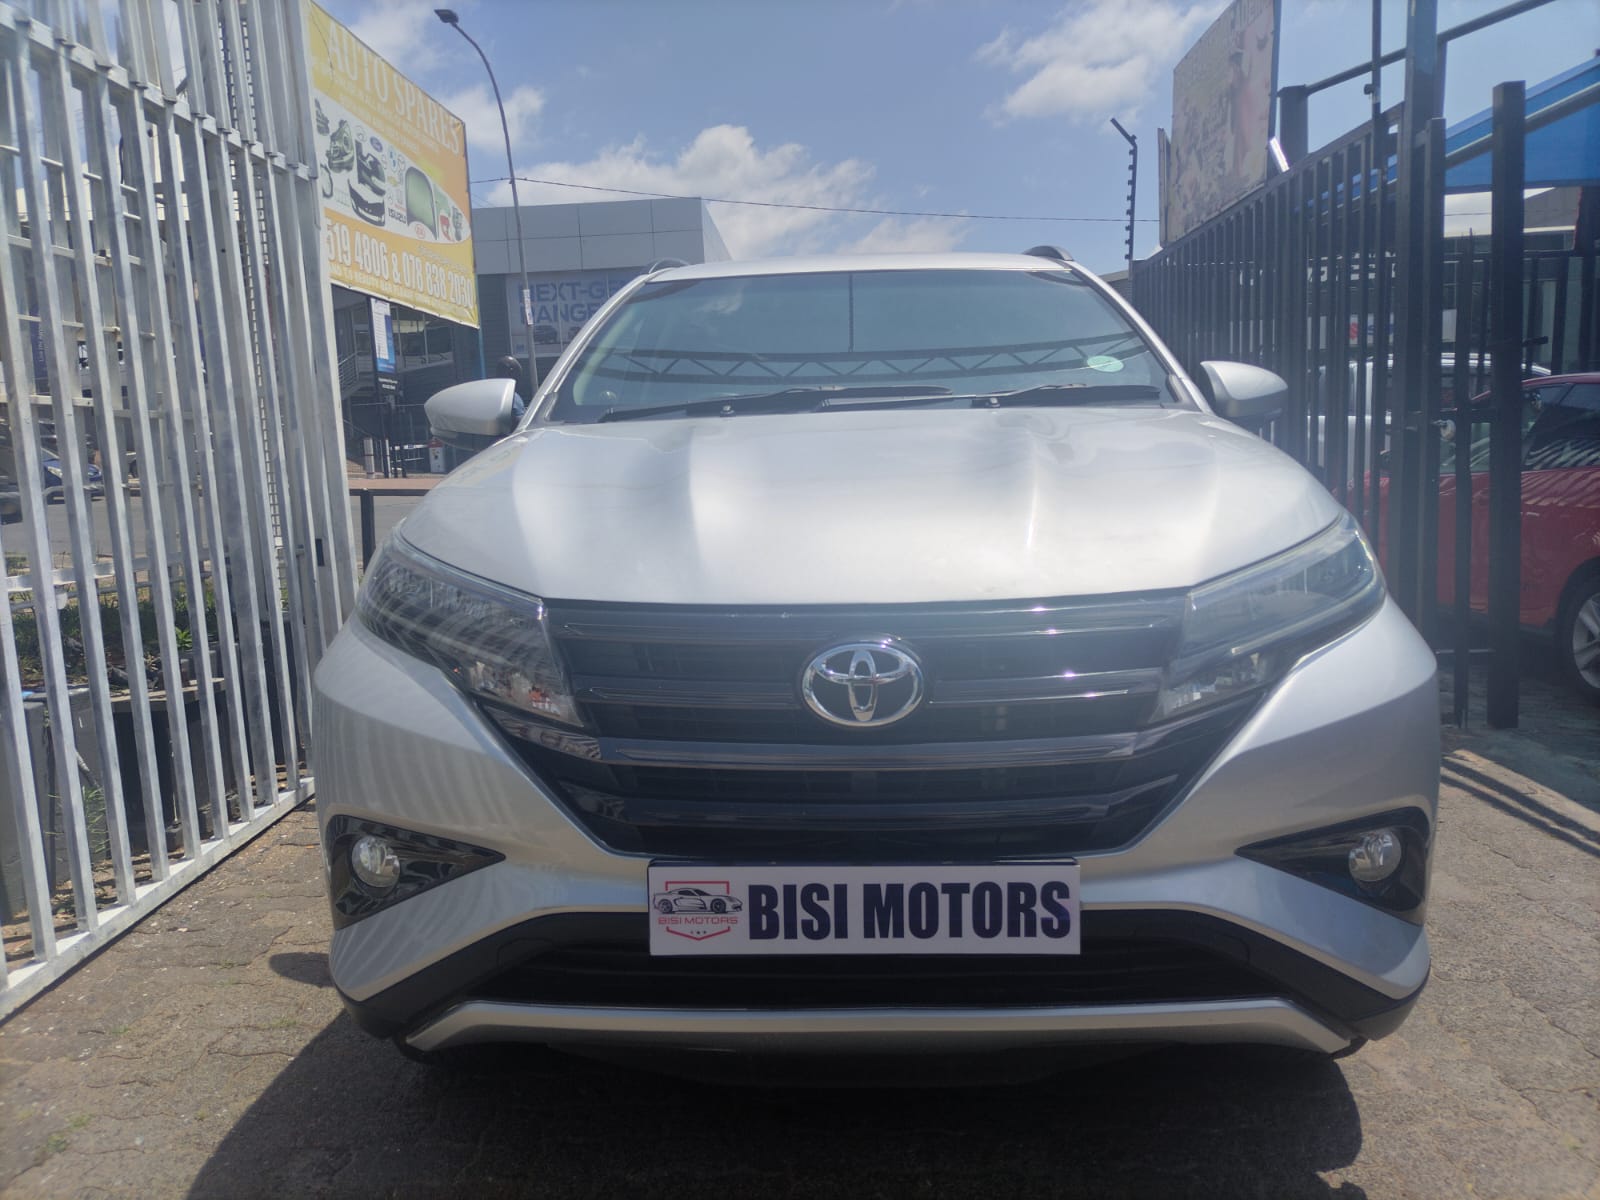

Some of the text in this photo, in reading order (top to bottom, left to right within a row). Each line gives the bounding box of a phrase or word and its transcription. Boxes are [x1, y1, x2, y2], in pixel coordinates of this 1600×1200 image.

[328, 20, 389, 104] AUTO
[393, 70, 460, 157] SPARES
[354, 232, 389, 281] 4806
[391, 252, 402, 285] &
[658, 916, 739, 925] BISI MOTORS
[748, 881, 1071, 940] BISI MOTORS
